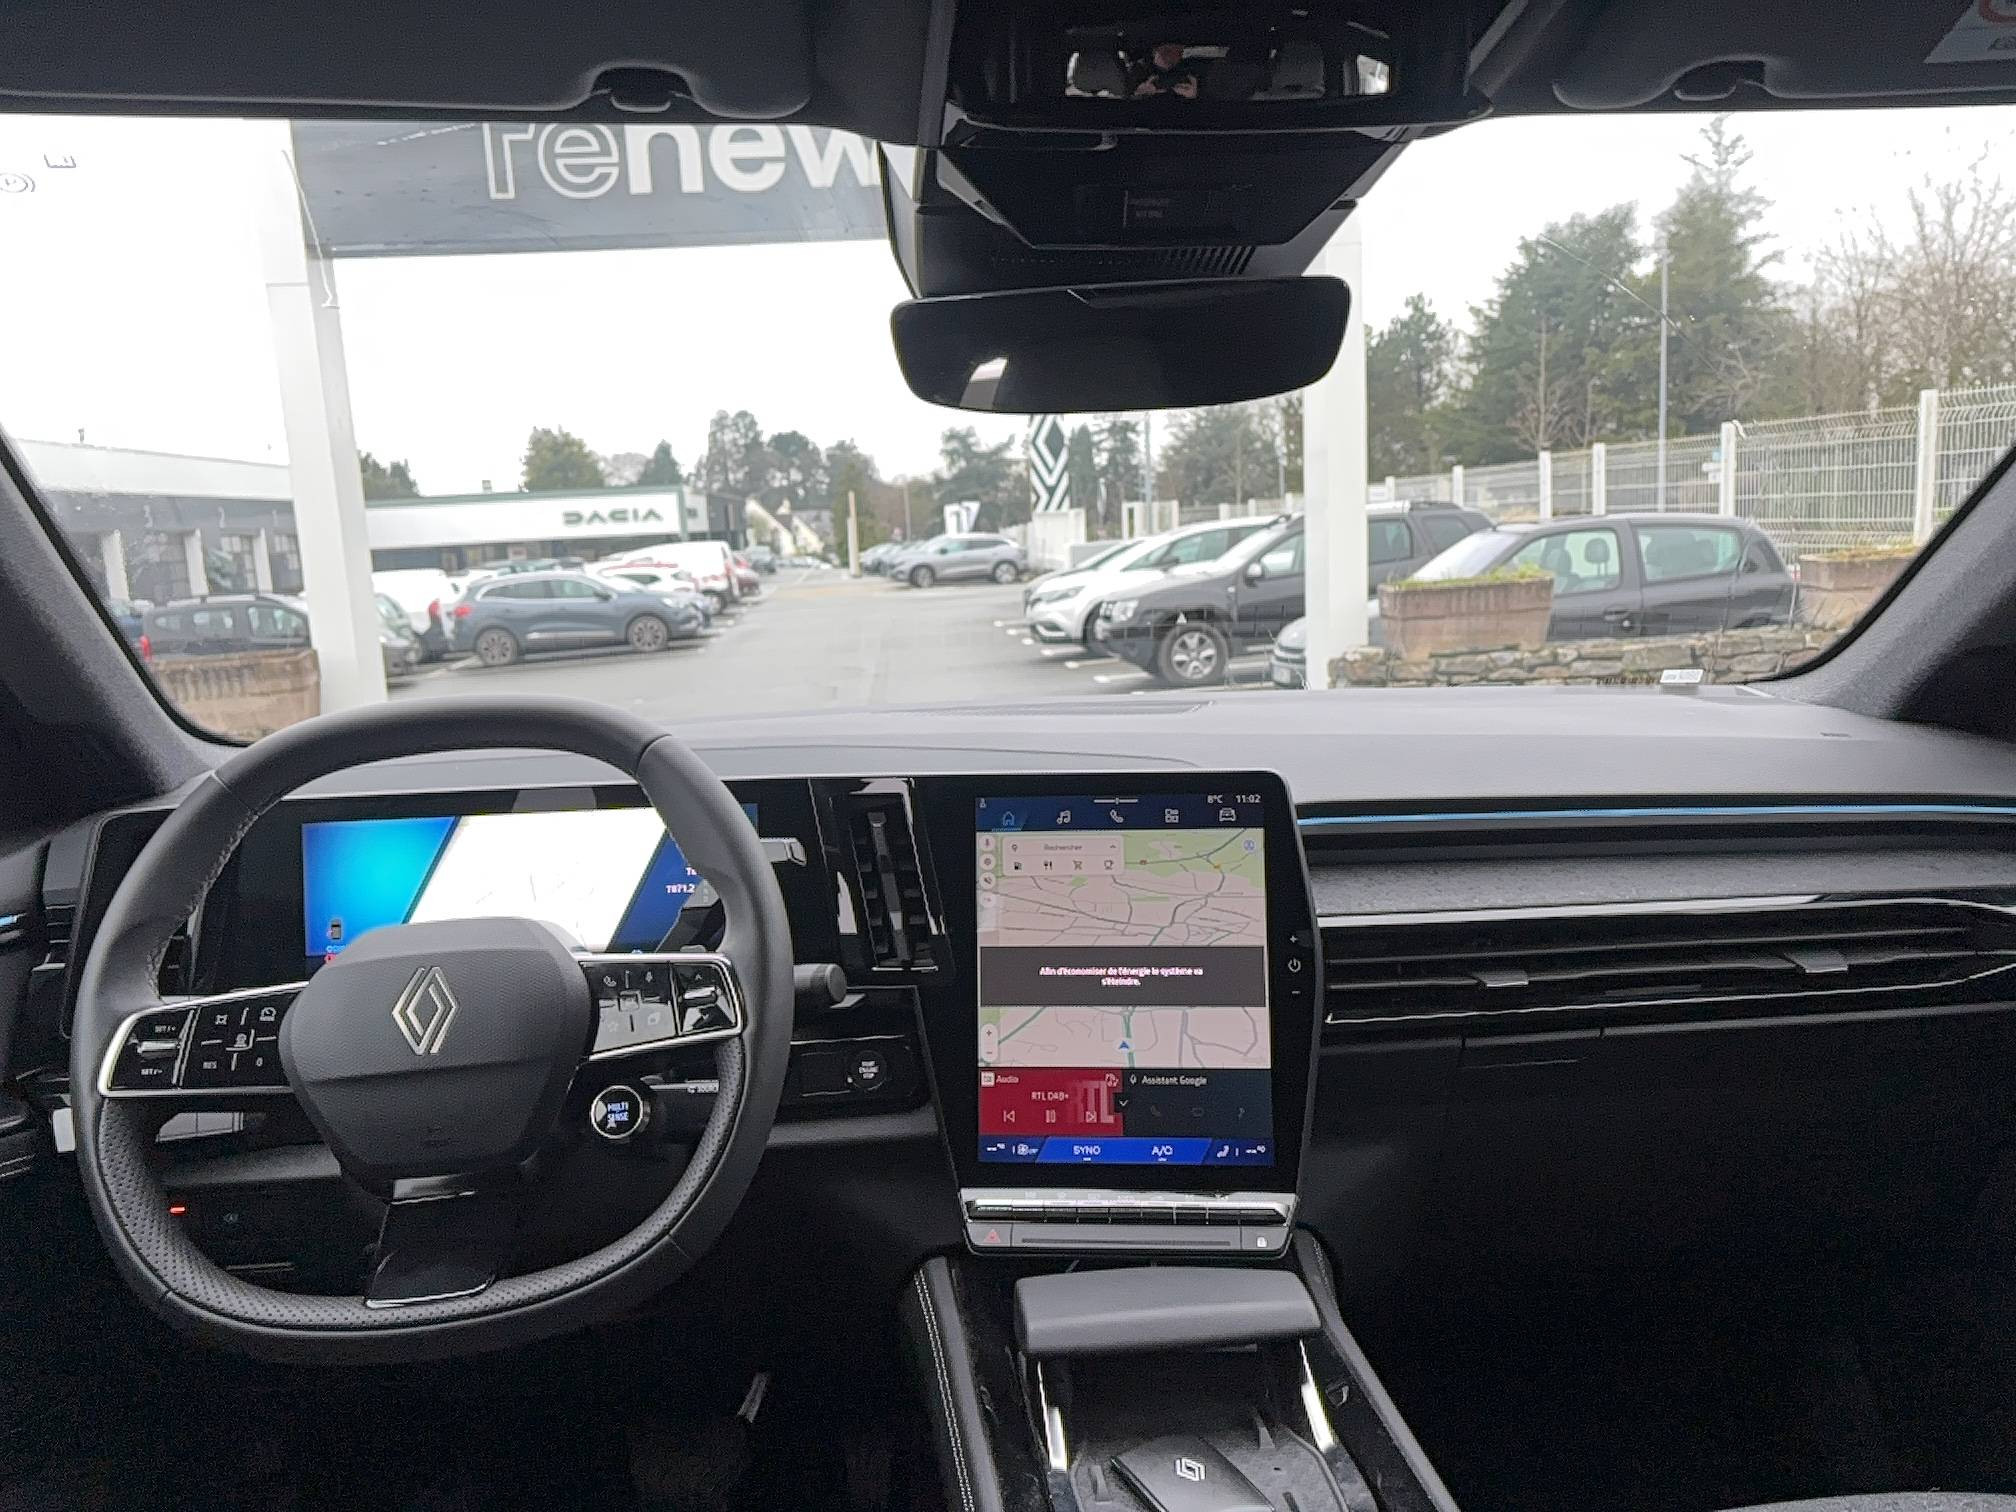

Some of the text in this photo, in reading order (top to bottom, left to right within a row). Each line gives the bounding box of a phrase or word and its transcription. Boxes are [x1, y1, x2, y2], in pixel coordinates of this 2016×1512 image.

[482, 121, 880, 199] renew
[562, 508, 664, 526] DACIA
[1235, 794, 1261, 804] 11:02
[996, 1074, 1019, 1084] Audio
[1141, 1075, 1208, 1088] Assistant Google
[1031, 1091, 1047, 1101] RTL
